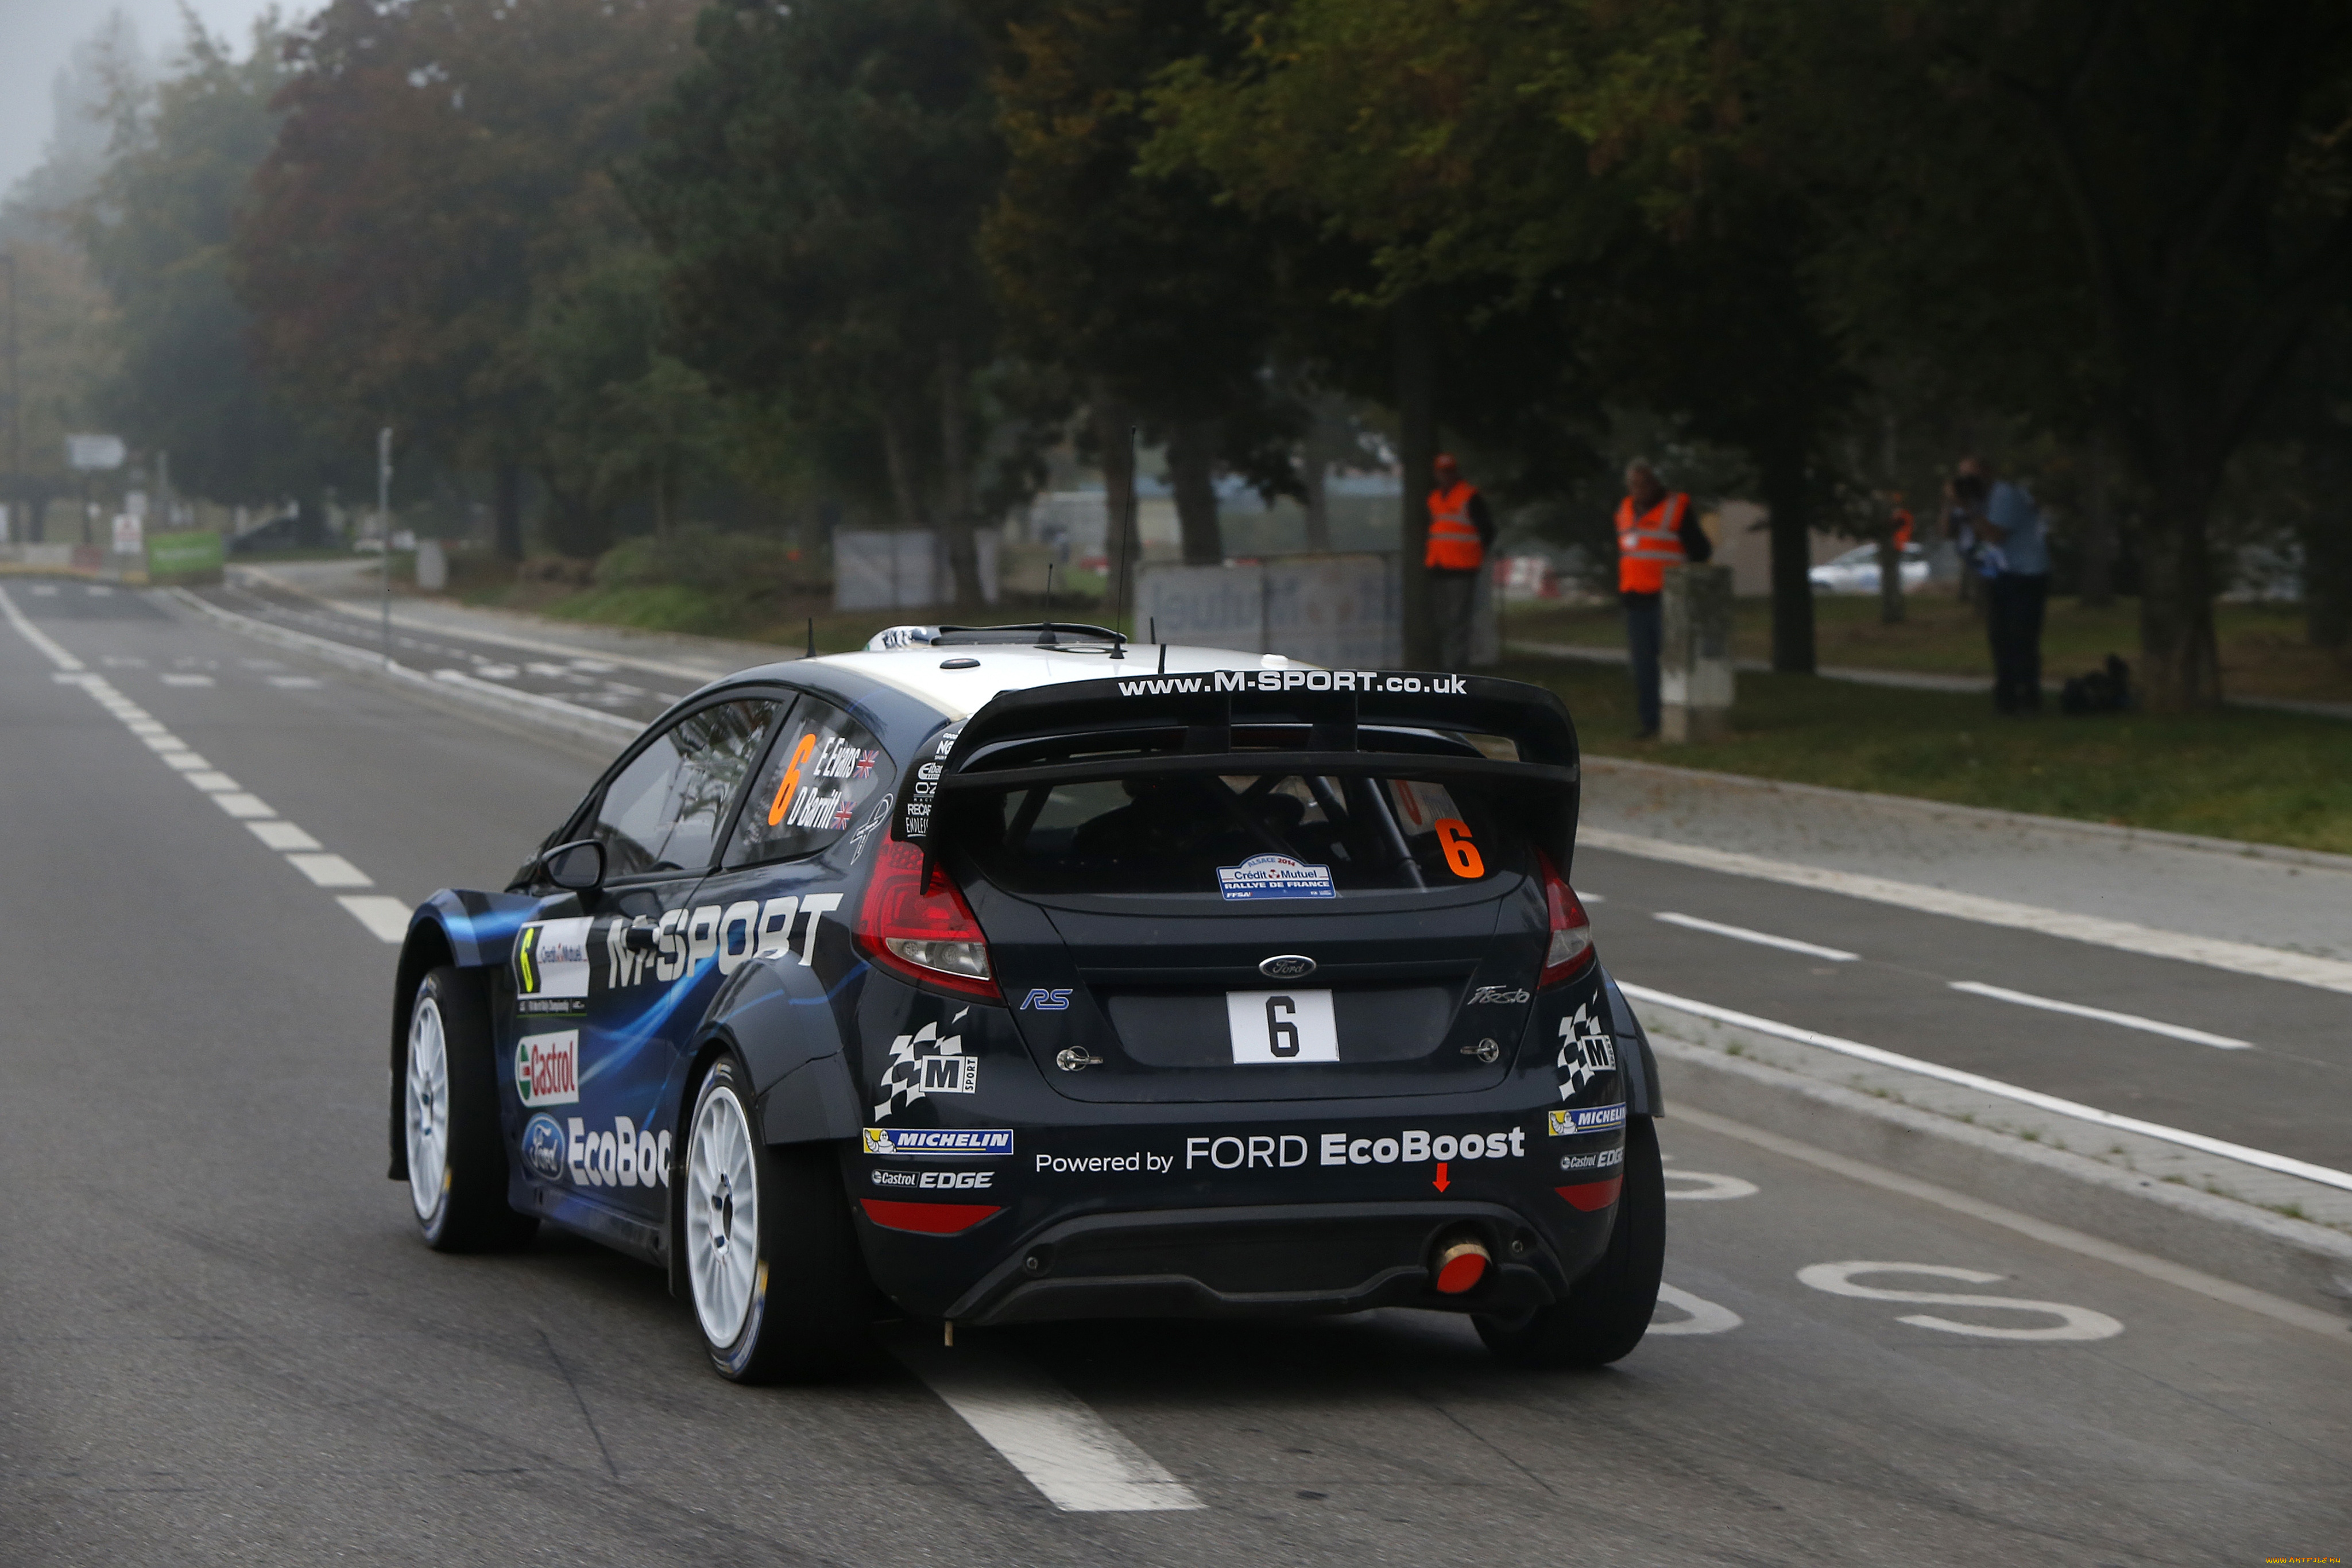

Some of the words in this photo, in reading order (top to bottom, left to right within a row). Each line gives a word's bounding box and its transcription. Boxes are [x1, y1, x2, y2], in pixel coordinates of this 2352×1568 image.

[1119, 671, 1467, 696] www.M-SPORT.co.uk
[813, 737, 835, 775] E
[823, 738, 861, 777] Evans
[768, 734, 816, 826] 6
[787, 787, 808, 826] D
[797, 787, 842, 829] Barritt
[1248, 857, 1275, 868] ALSACE
[1277, 857, 1295, 867] 2014
[1435, 818, 1485, 878] 6
[1224, 881, 1267, 889] RALLYE
[1235, 871, 1267, 880] Crédit
[1281, 870, 1317, 878] Mutuel
[607, 893, 844, 989] M-SPORT
[1272, 959, 1305, 974] Ford
[1020, 989, 1073, 1010] RS
[1266, 996, 1300, 1057] 6
[1583, 1038, 1610, 1067] M
[531, 1041, 575, 1096] Castrol
[925, 1059, 958, 1089] M
[964, 1058, 976, 1091] SPORT
[896, 1133, 1009, 1147] MICHELIN
[1036, 1152, 1139, 1172] Powered
[1147, 1152, 1174, 1174] by
[1186, 1136, 1308, 1170] FORD
[1320, 1126, 1525, 1166] EcoBoost
[1570, 1155, 1596, 1169] Castrol
[881, 1171, 916, 1186] Castrol
[919, 1172, 995, 1189] EDGE
